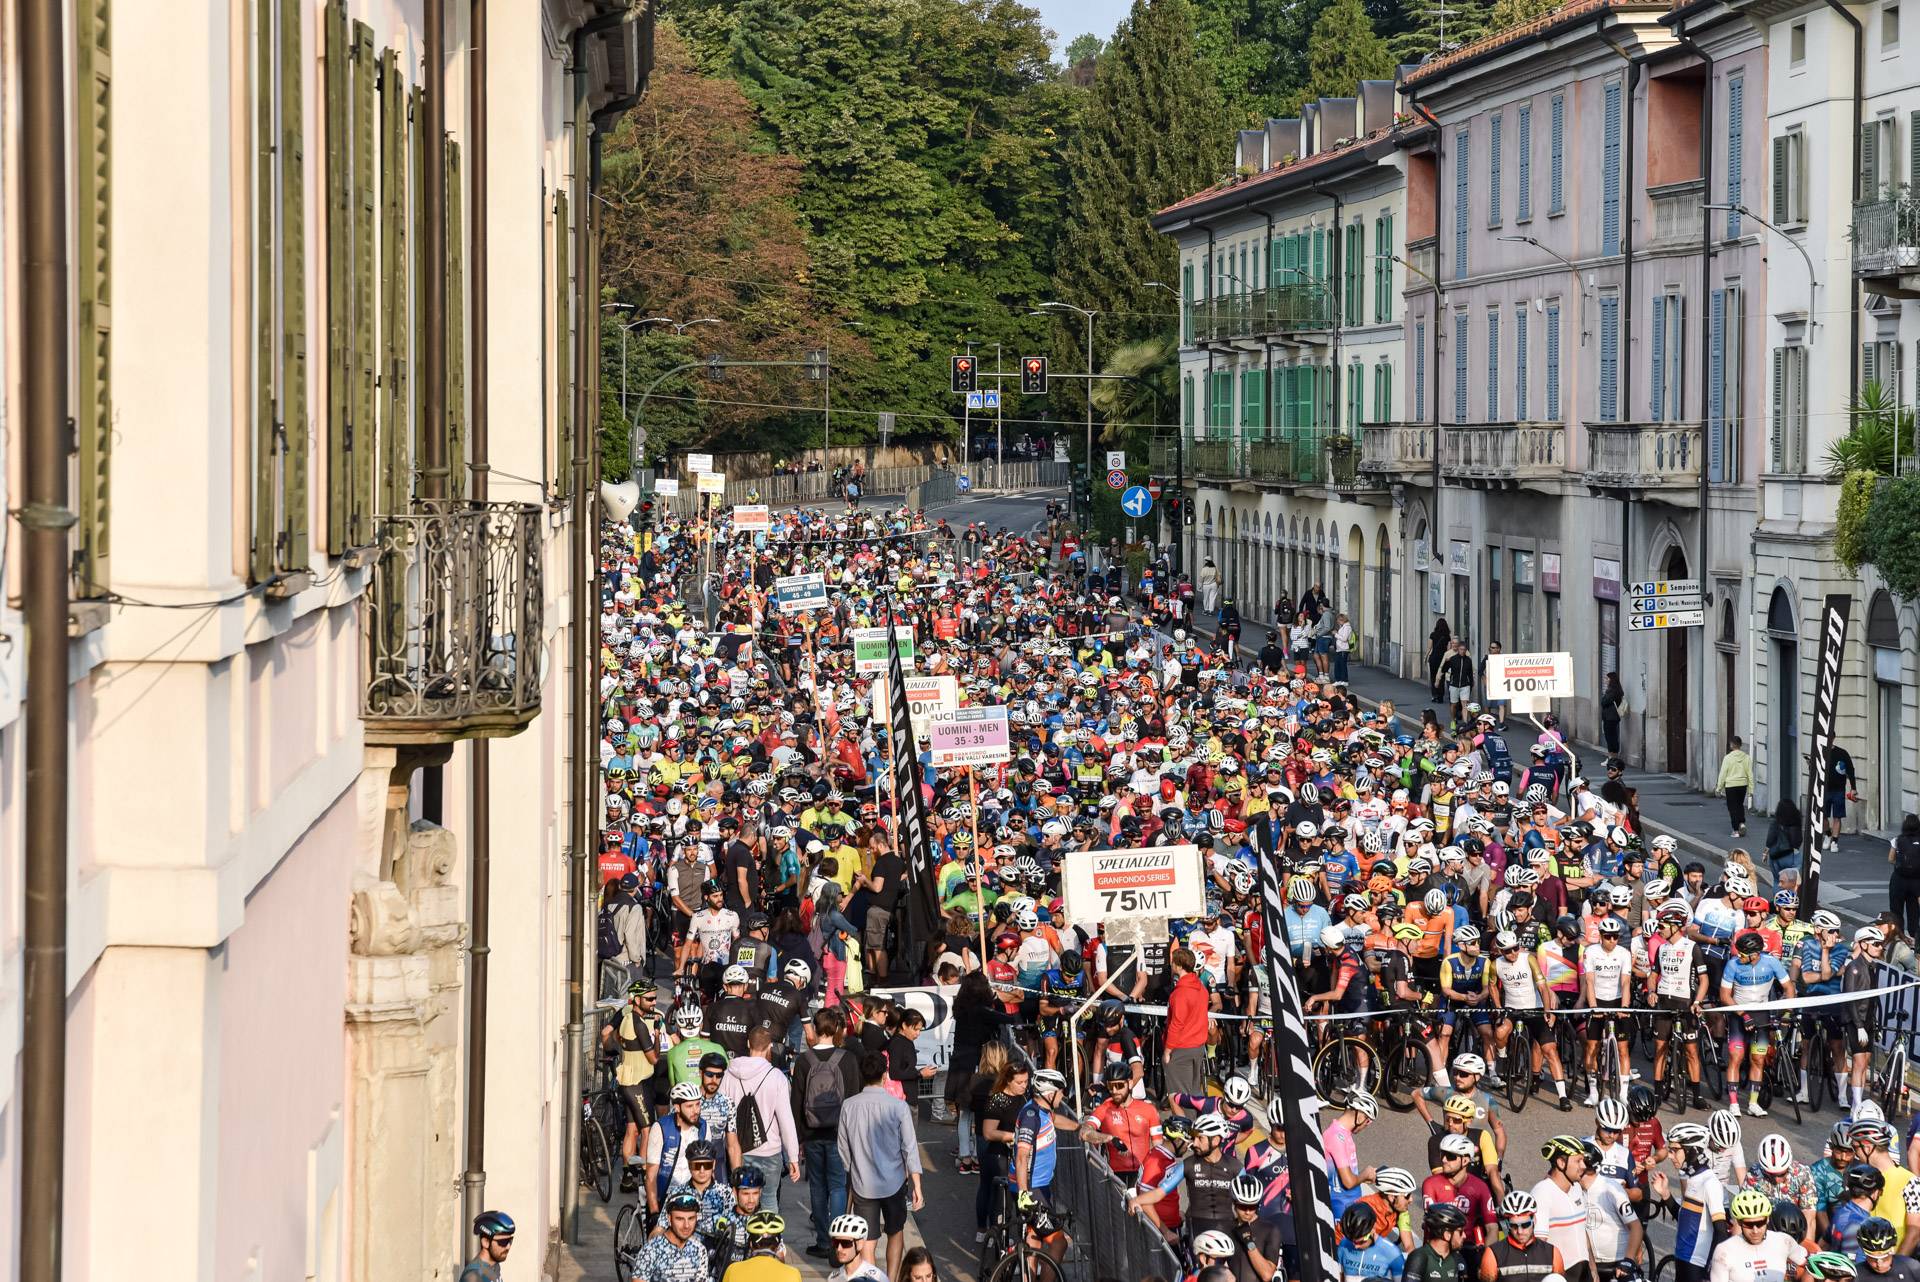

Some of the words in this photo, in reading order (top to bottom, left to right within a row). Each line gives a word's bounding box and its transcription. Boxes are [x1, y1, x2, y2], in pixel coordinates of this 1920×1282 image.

[1670, 584, 1699, 592] Sempione
[861, 642, 887, 650] UOMINI
[1503, 678, 1558, 692] 100MT
[935, 712, 954, 721] UCI
[938, 725, 972, 736] UOMINI
[979, 723, 999, 733] MEN
[954, 736, 966, 746] 35
[973, 735, 985, 745] 39
[1097, 854, 1171, 870] SPECIALIZED
[1098, 875, 1145, 886] GRANFONDO
[1147, 872, 1171, 882] SERIES
[1100, 889, 1172, 913] 75MT
[739, 950, 754, 960] 2026
[760, 992, 790, 1008] CRENNESE
[726, 1015, 737, 1024] S.C.
[715, 1022, 748, 1033] CRENNESE
